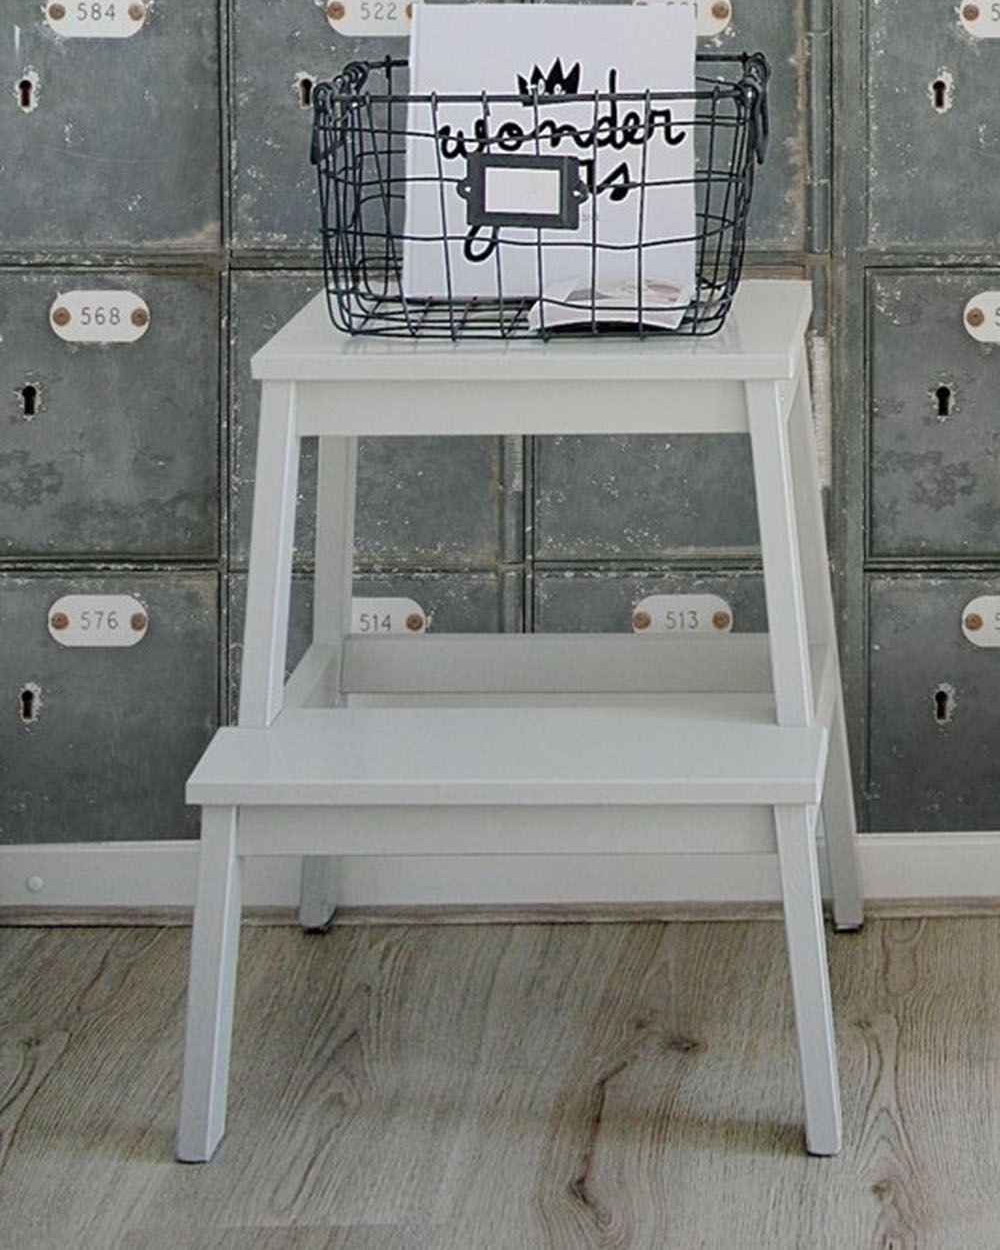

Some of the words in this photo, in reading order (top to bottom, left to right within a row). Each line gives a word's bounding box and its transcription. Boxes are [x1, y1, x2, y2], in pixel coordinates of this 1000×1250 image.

[76, 1, 116, 22] 584
[360, 1, 398, 21] 522
[439, 69, 686, 159] wonder
[80, 306, 121, 326] 568
[80, 610, 119, 631] 576
[359, 612, 392, 633] 514
[665, 610, 699, 630] 513
